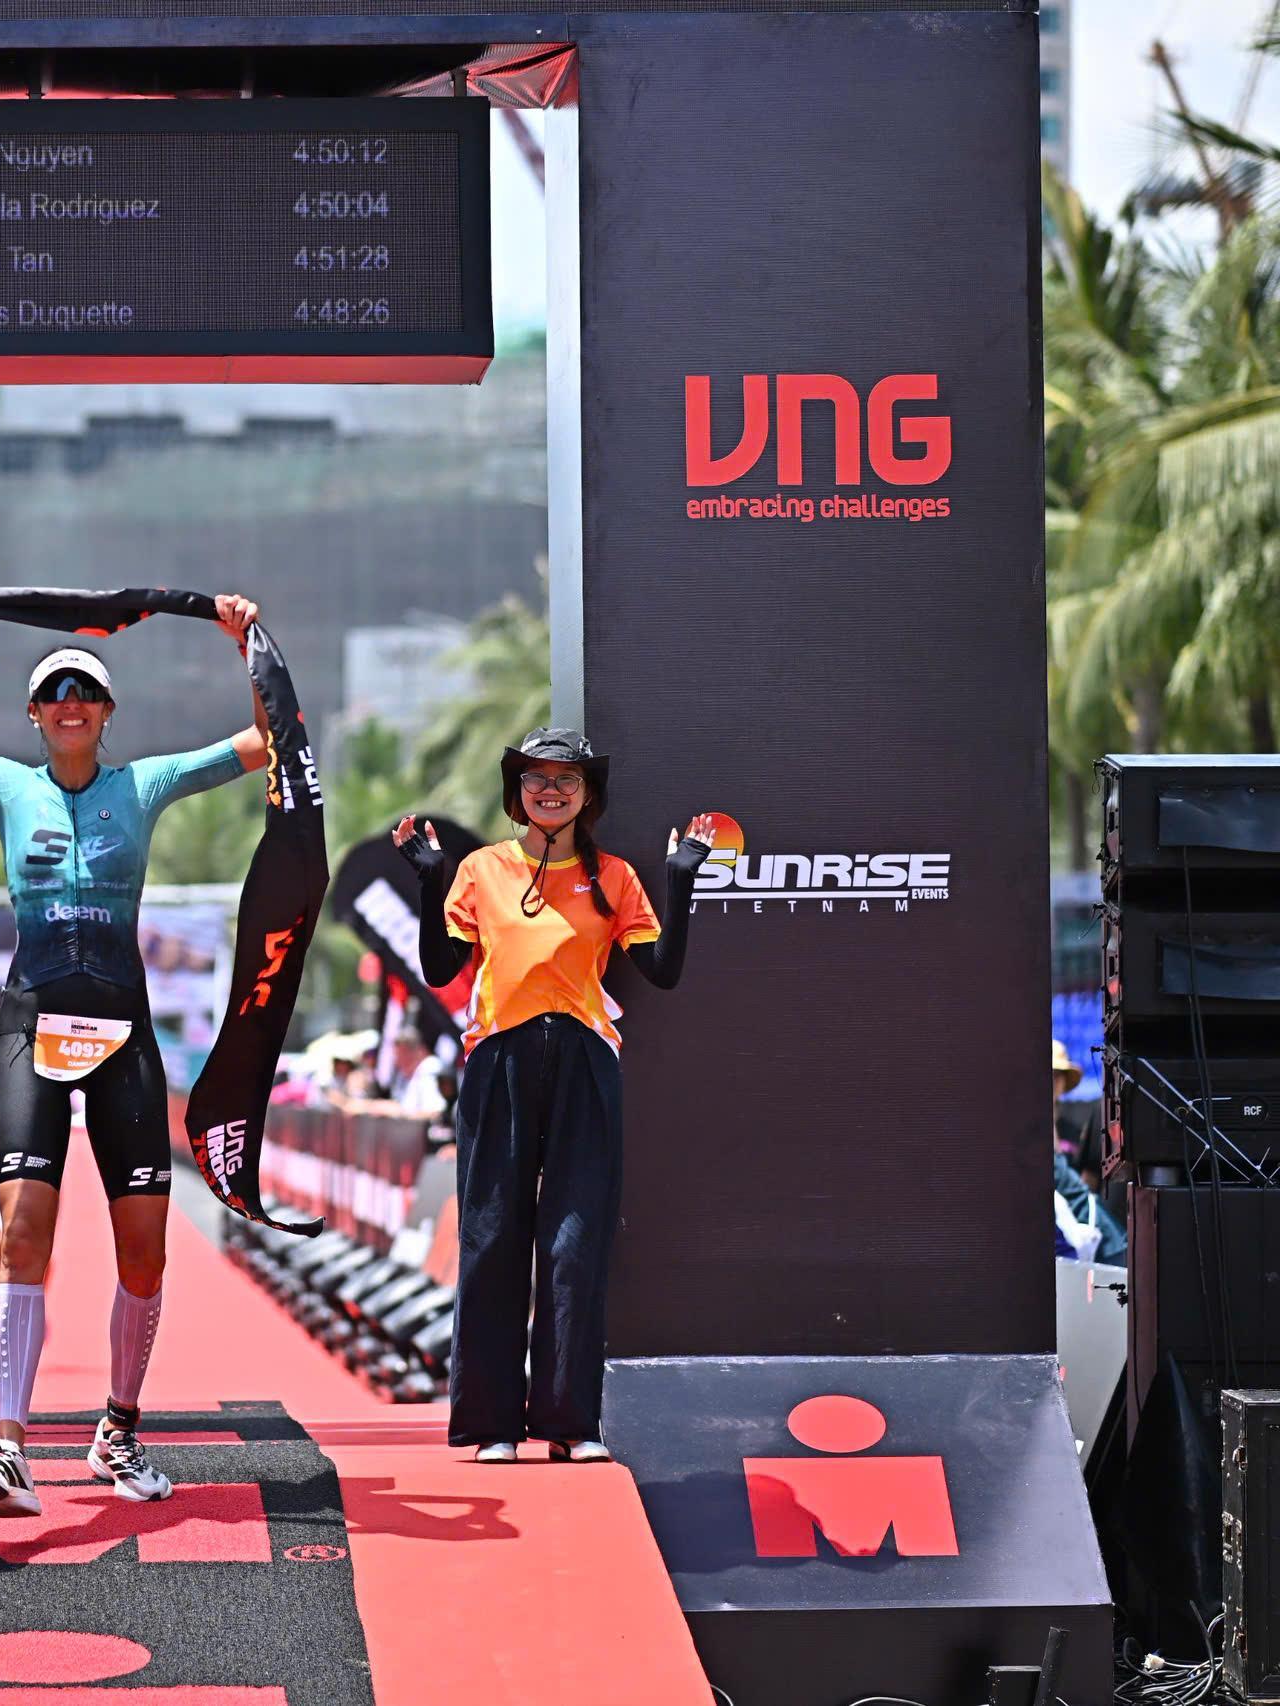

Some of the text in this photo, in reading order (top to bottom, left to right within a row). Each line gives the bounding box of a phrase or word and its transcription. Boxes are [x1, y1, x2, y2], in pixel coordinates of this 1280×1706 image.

[293, 139, 388, 164] 4:50:12
[30, 192, 159, 224] Rodriguez
[293, 191, 389, 219] 4:50:04
[8, 246, 53, 273] Tan
[294, 246, 389, 271] 4:51:28
[19, 300, 133, 331] Duquette
[293, 297, 390, 323] 4:48:26
[687, 493, 951, 523] embracing challenges
[911, 887, 949, 900] EVENTS
[45, 901, 111, 924] deem
[58, 1039, 106, 1058] 4092
[1243, 1105, 1263, 1116] RCF
